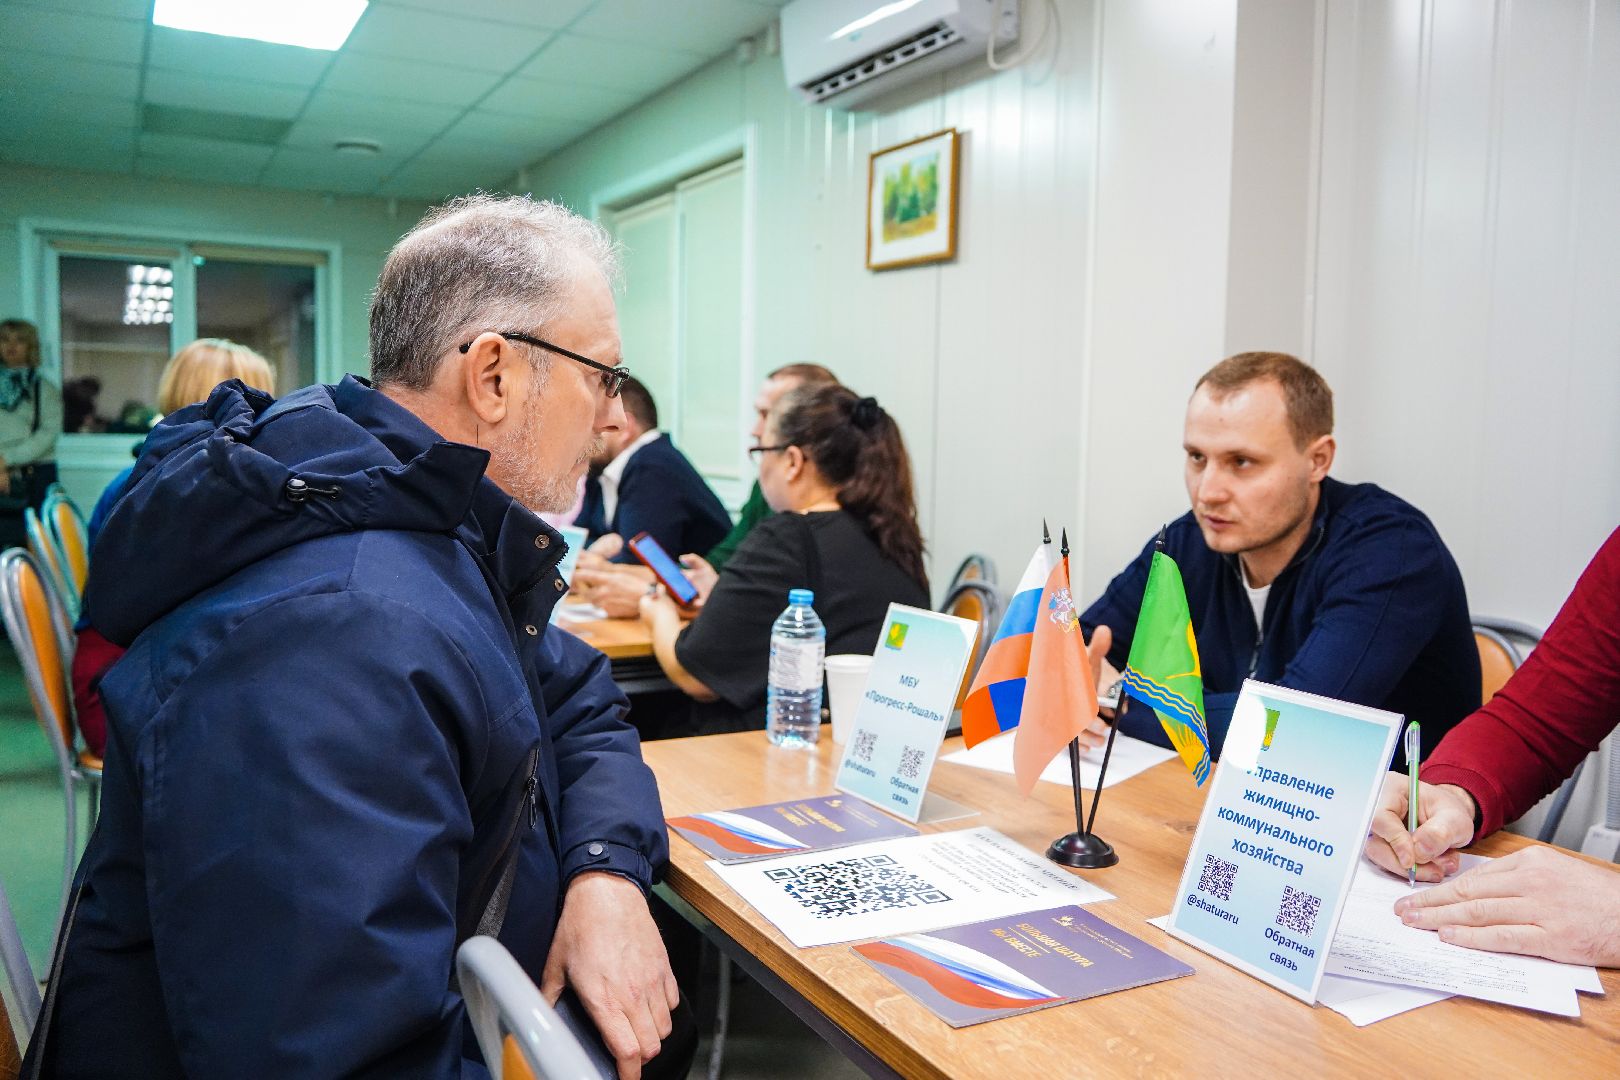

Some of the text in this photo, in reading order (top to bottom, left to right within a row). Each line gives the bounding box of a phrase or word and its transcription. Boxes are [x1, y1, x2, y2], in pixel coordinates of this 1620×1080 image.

[899, 674, 920, 689] МБУ
[865, 690, 945, 723] «Прогресс-Рошаль»
[890, 776, 920, 795] Обратная
[1246, 765, 1335, 800] правление
[1243, 788, 1321, 823] жилищно-
[1217, 806, 1335, 858] коммунального
[1231, 837, 1305, 877] хозяйства
[1187, 894, 1240, 925] @shaturaru
[1264, 927, 1316, 960] Обратная
[1269, 951, 1299, 973] связь
